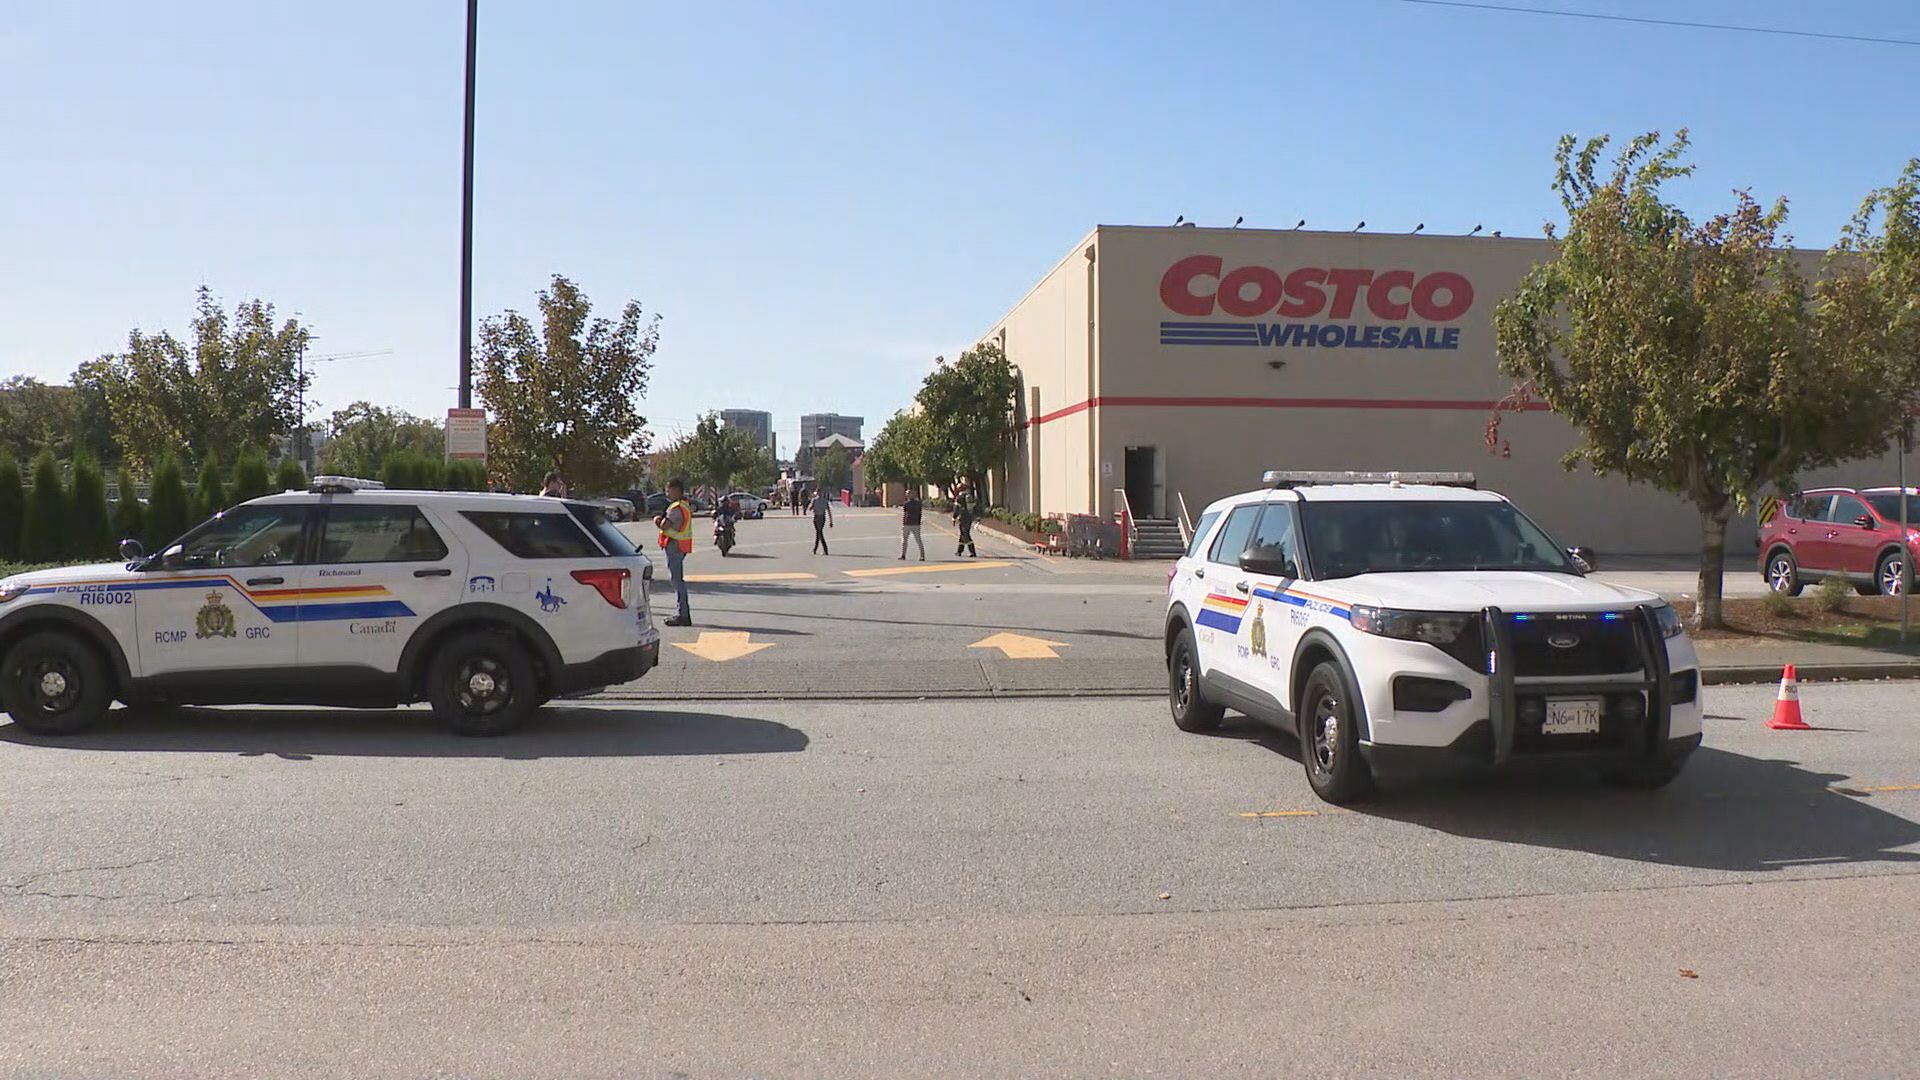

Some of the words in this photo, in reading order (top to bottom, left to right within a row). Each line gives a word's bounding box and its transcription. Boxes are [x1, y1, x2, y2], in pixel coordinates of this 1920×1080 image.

[1160, 255, 1474, 321] COSTCO
[1256, 323, 1460, 350] WHOLESALE
[319, 569, 361, 577] Richmond
[57, 584, 106, 593] POLICE
[80, 592, 132, 605] RI6002
[350, 622, 396, 634] Canada
[155, 631, 187, 643] RCMP
[245, 627, 270, 639] GRC
[1546, 711, 1568, 725] N6
